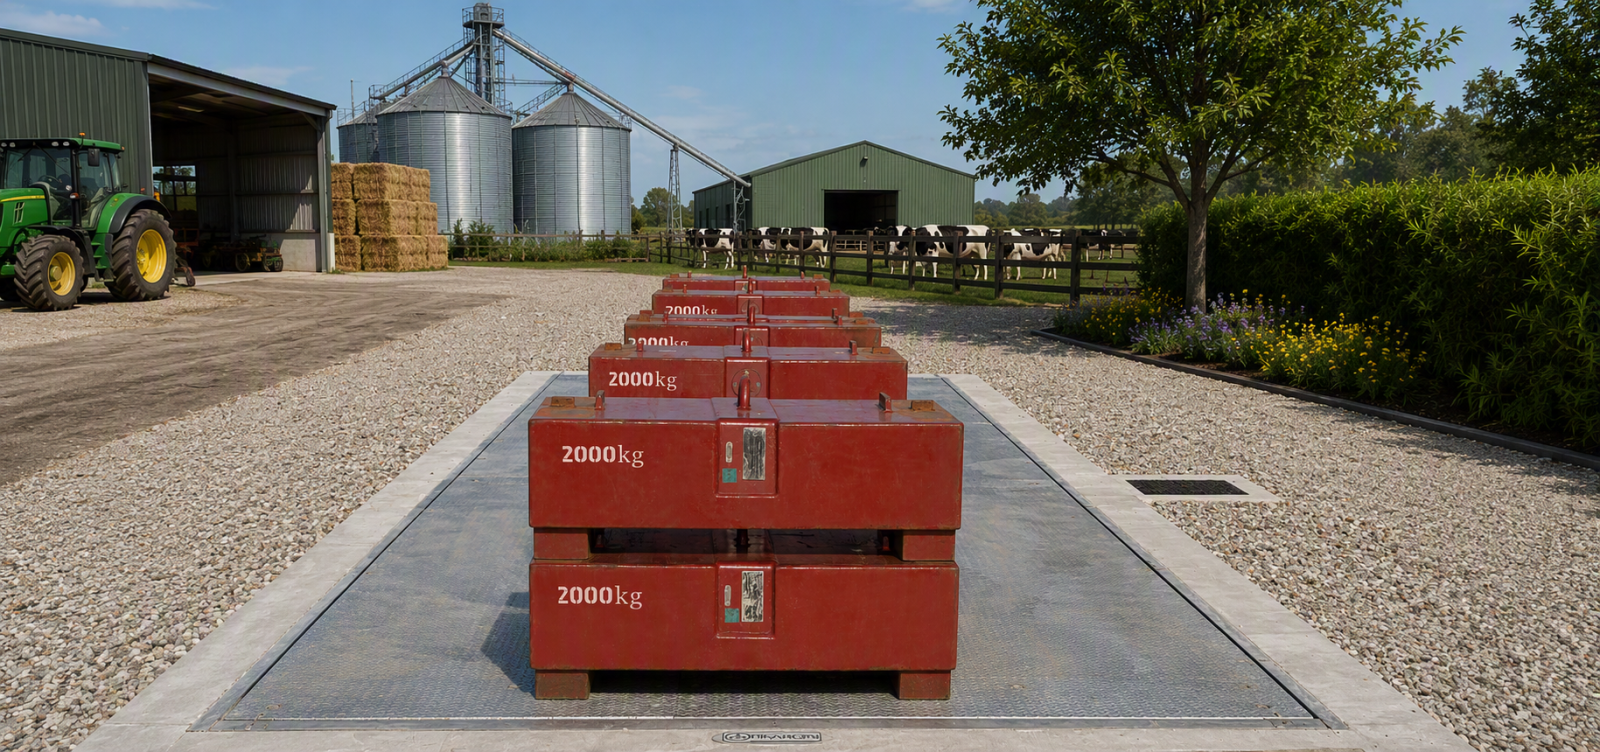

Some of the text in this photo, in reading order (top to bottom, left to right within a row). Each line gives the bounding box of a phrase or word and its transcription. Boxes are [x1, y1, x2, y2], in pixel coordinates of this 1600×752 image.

[608, 370, 678, 391] 2000kg
[561, 444, 644, 468] 2000kg
[557, 584, 643, 610] 2000kg
